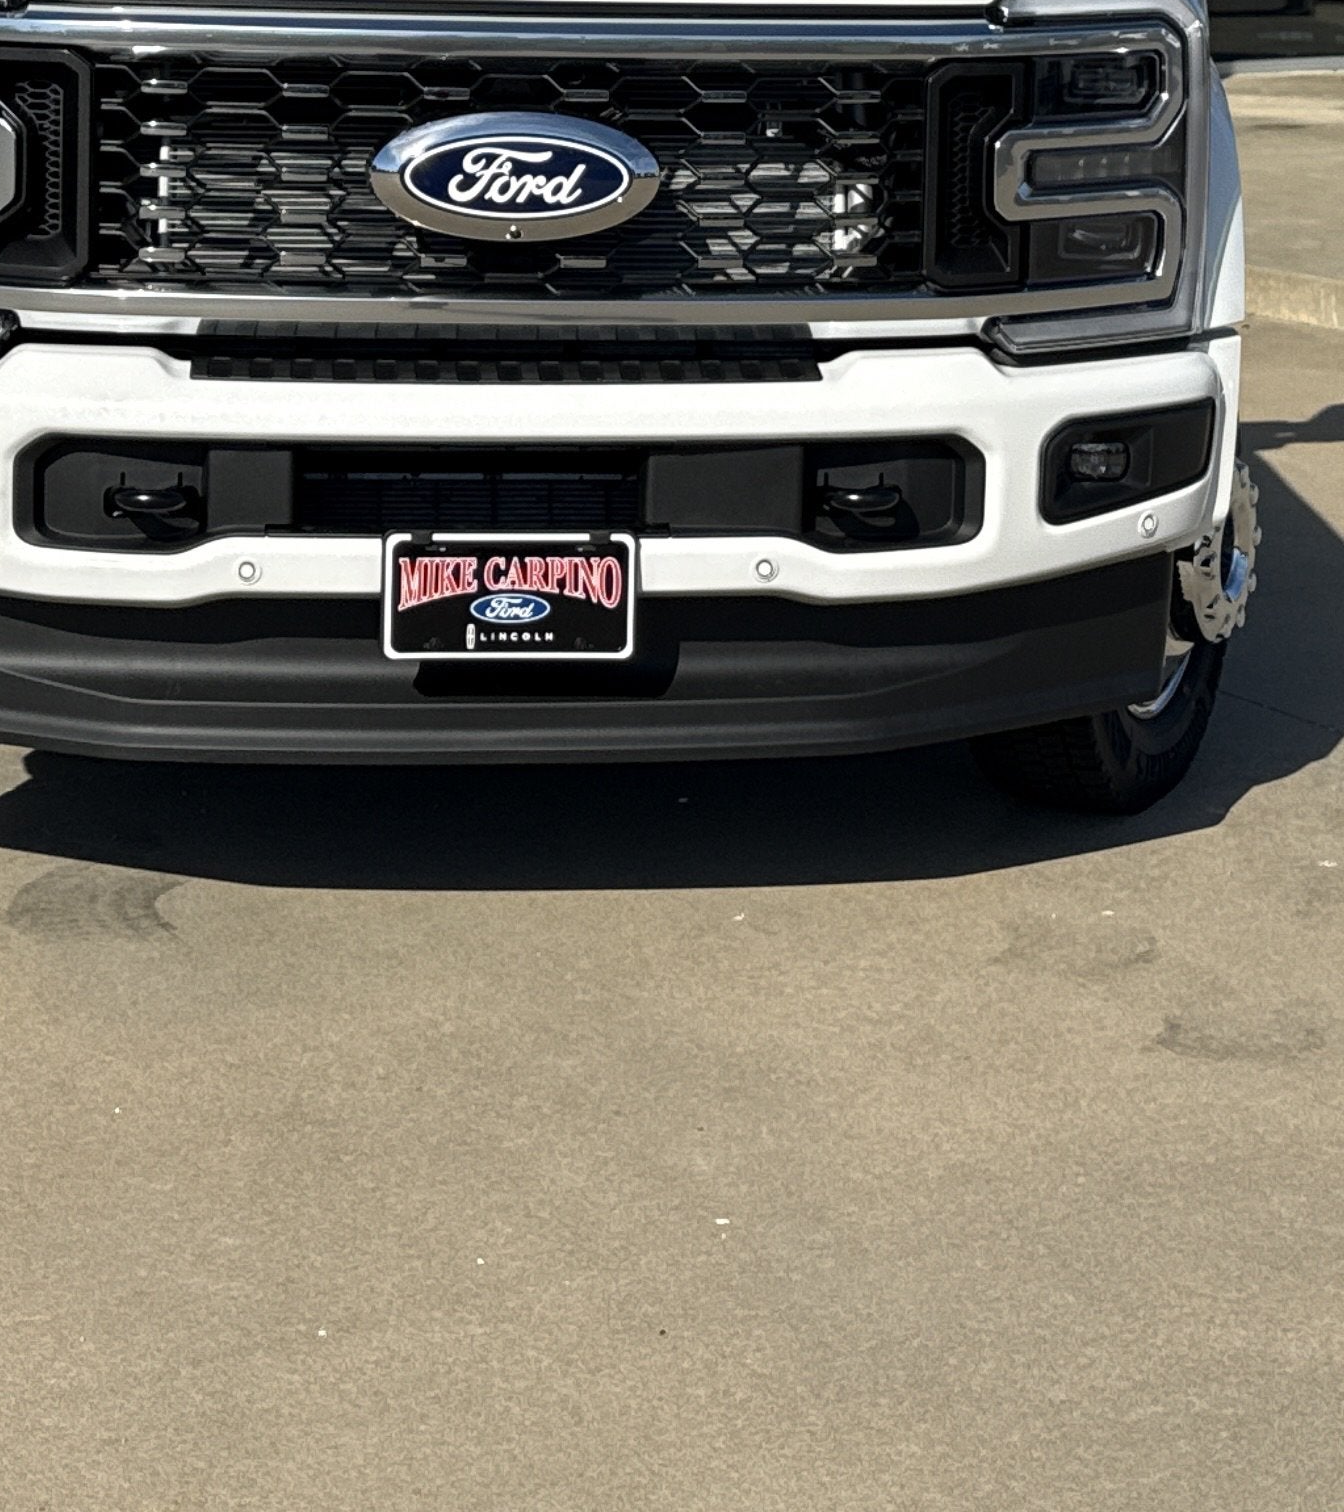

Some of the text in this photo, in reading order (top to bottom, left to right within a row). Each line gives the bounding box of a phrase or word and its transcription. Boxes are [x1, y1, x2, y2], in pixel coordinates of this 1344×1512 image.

[448, 146, 586, 205] Ford
[398, 556, 622, 611] MIKE CARPINO
[485, 597, 535, 618] Ford
[479, 631, 554, 642] LINCOLN
